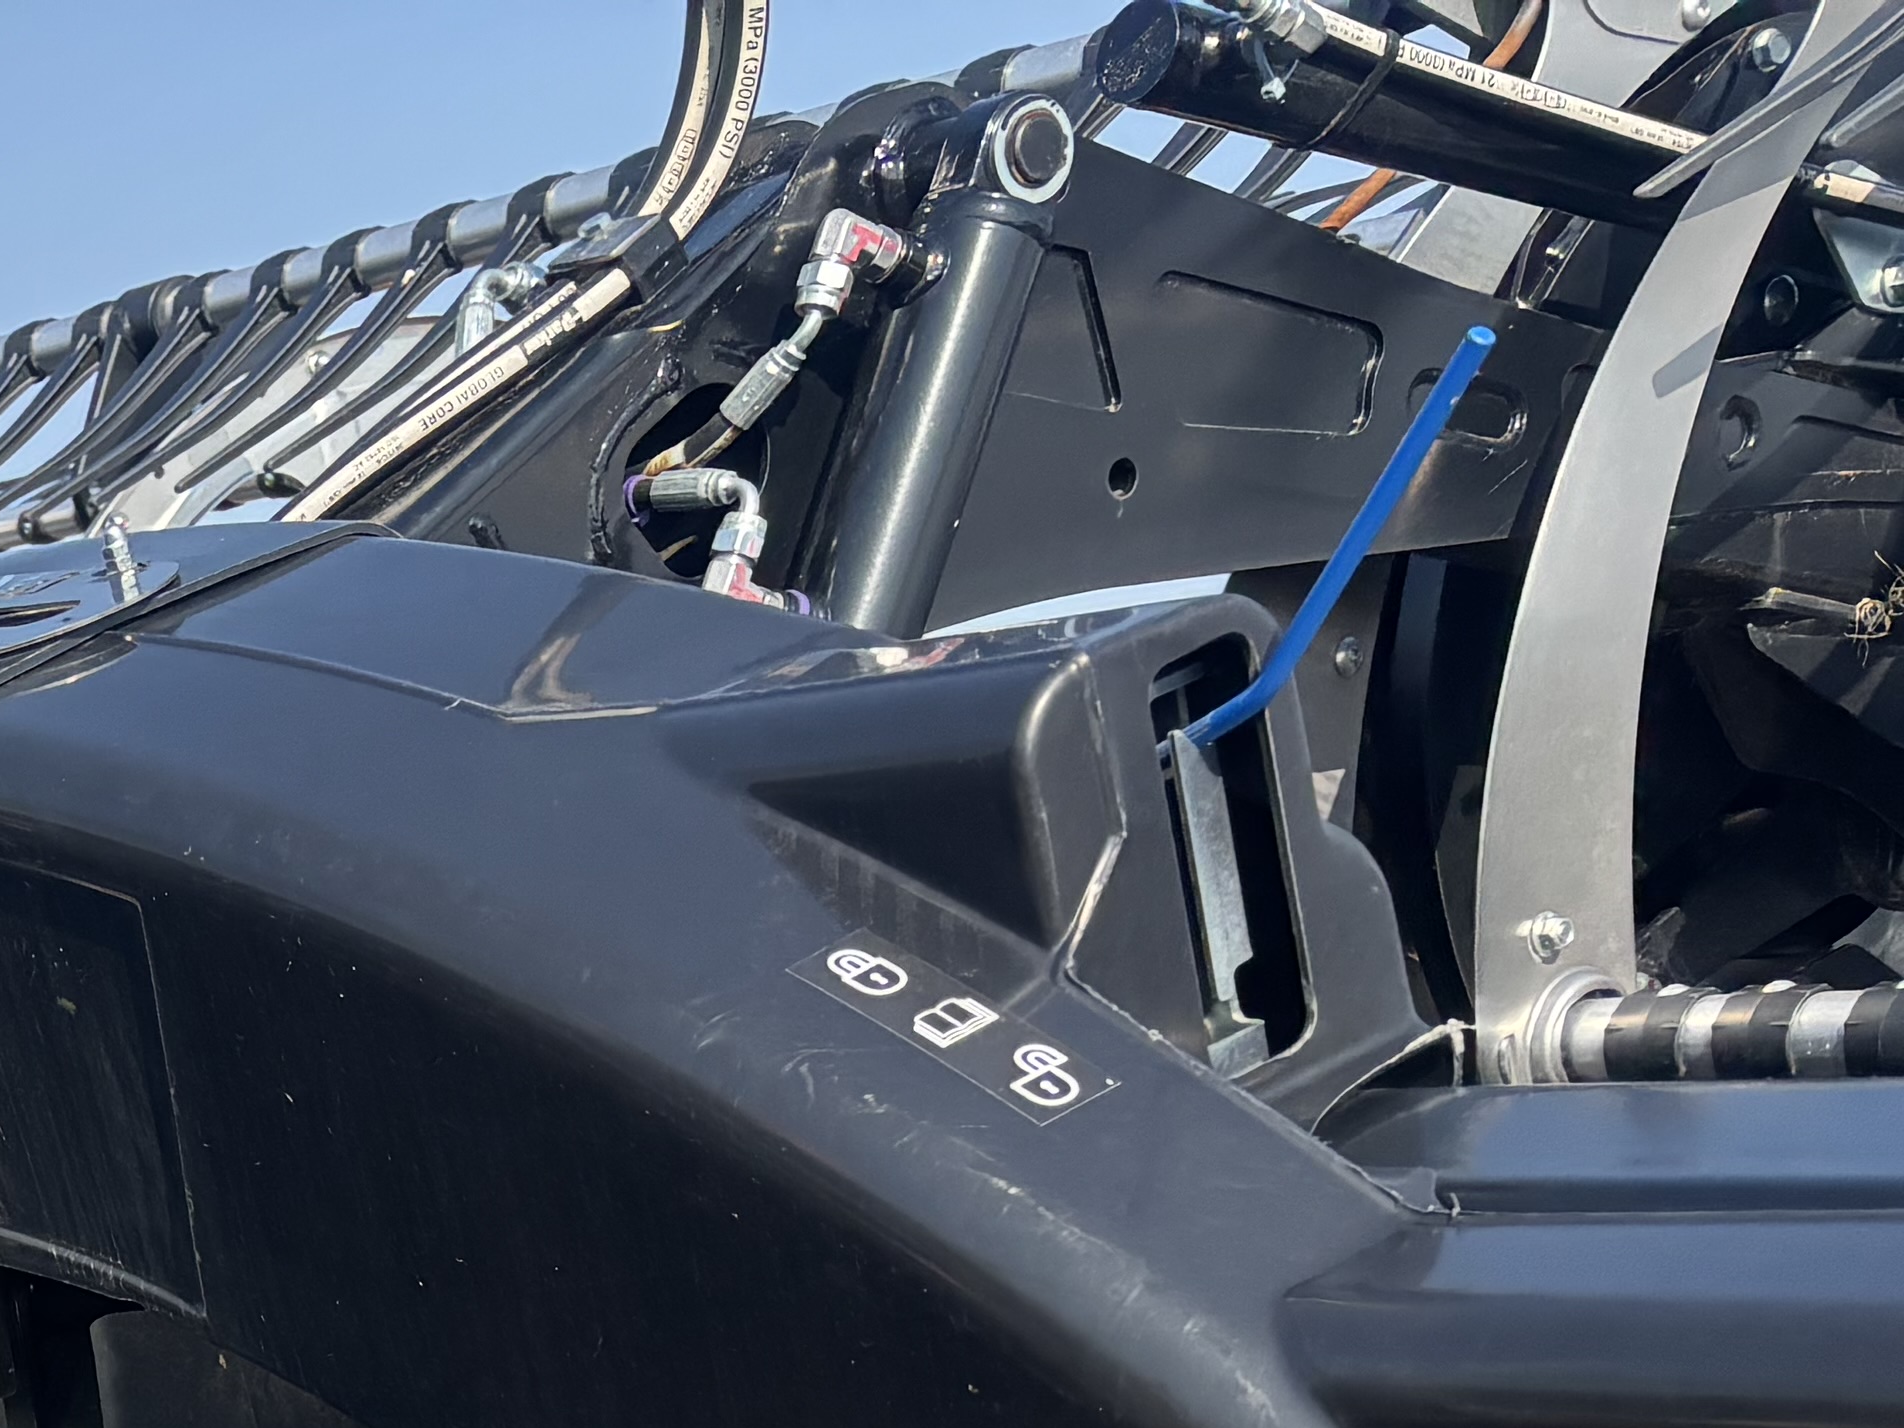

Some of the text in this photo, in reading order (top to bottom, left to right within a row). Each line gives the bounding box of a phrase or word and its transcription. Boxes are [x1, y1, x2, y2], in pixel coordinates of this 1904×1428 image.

[718, 6, 765, 159] MPa (3000 PSI)
